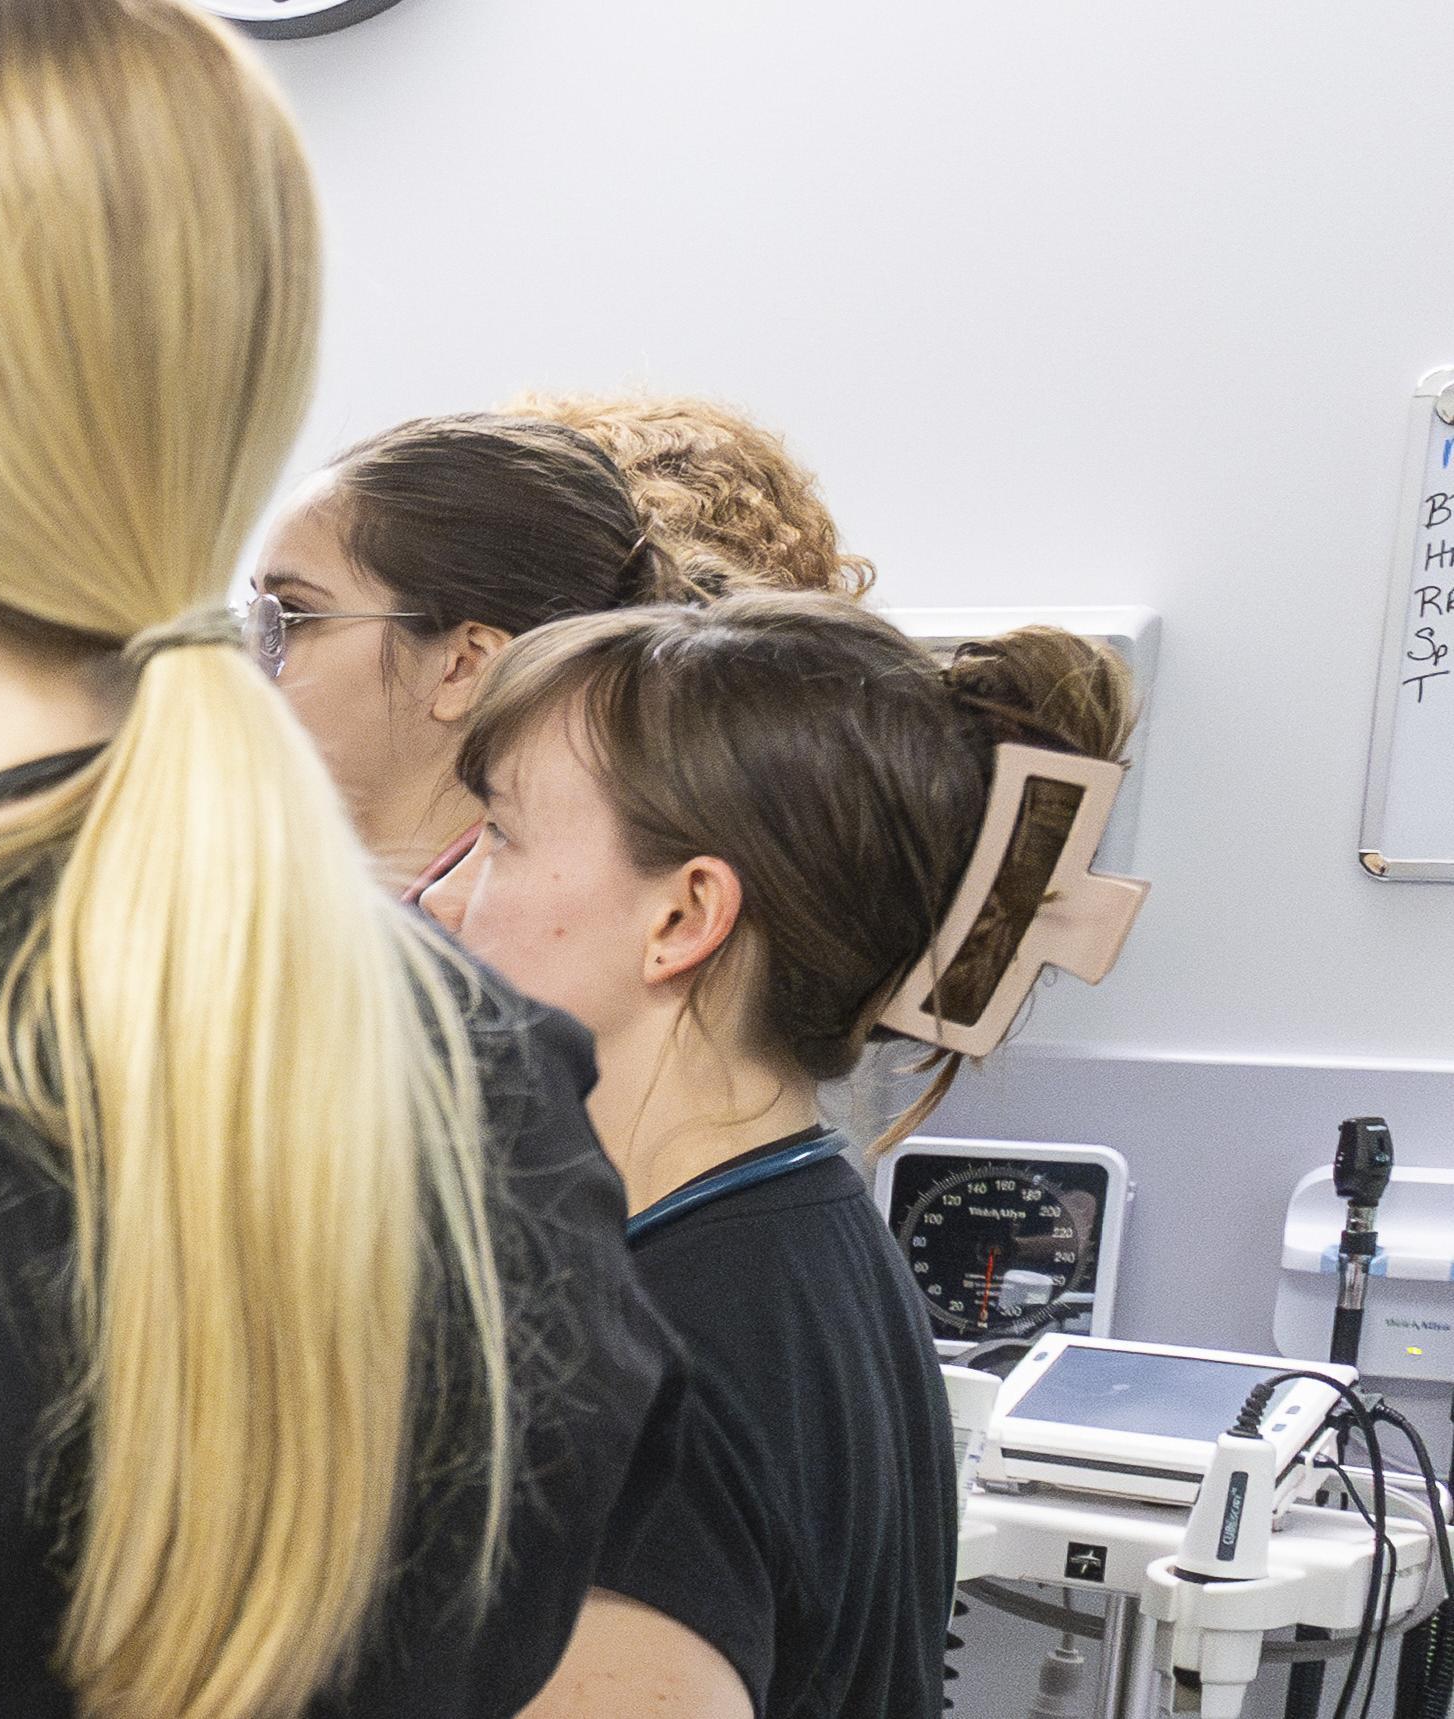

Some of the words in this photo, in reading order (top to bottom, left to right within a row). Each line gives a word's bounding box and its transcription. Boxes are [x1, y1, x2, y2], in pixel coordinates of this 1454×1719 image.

[1424, 492, 1454, 530] B
[1424, 539, 1454, 571] H
[1402, 670, 1451, 703] T
[966, 1183, 988, 1195] 140
[942, 1194, 962, 1206] 120
[923, 1212, 943, 1225] 100
[1054, 1251, 1075, 1264] 240
[1051, 1275, 1066, 1286] 60
[948, 1300, 965, 1313] 20
